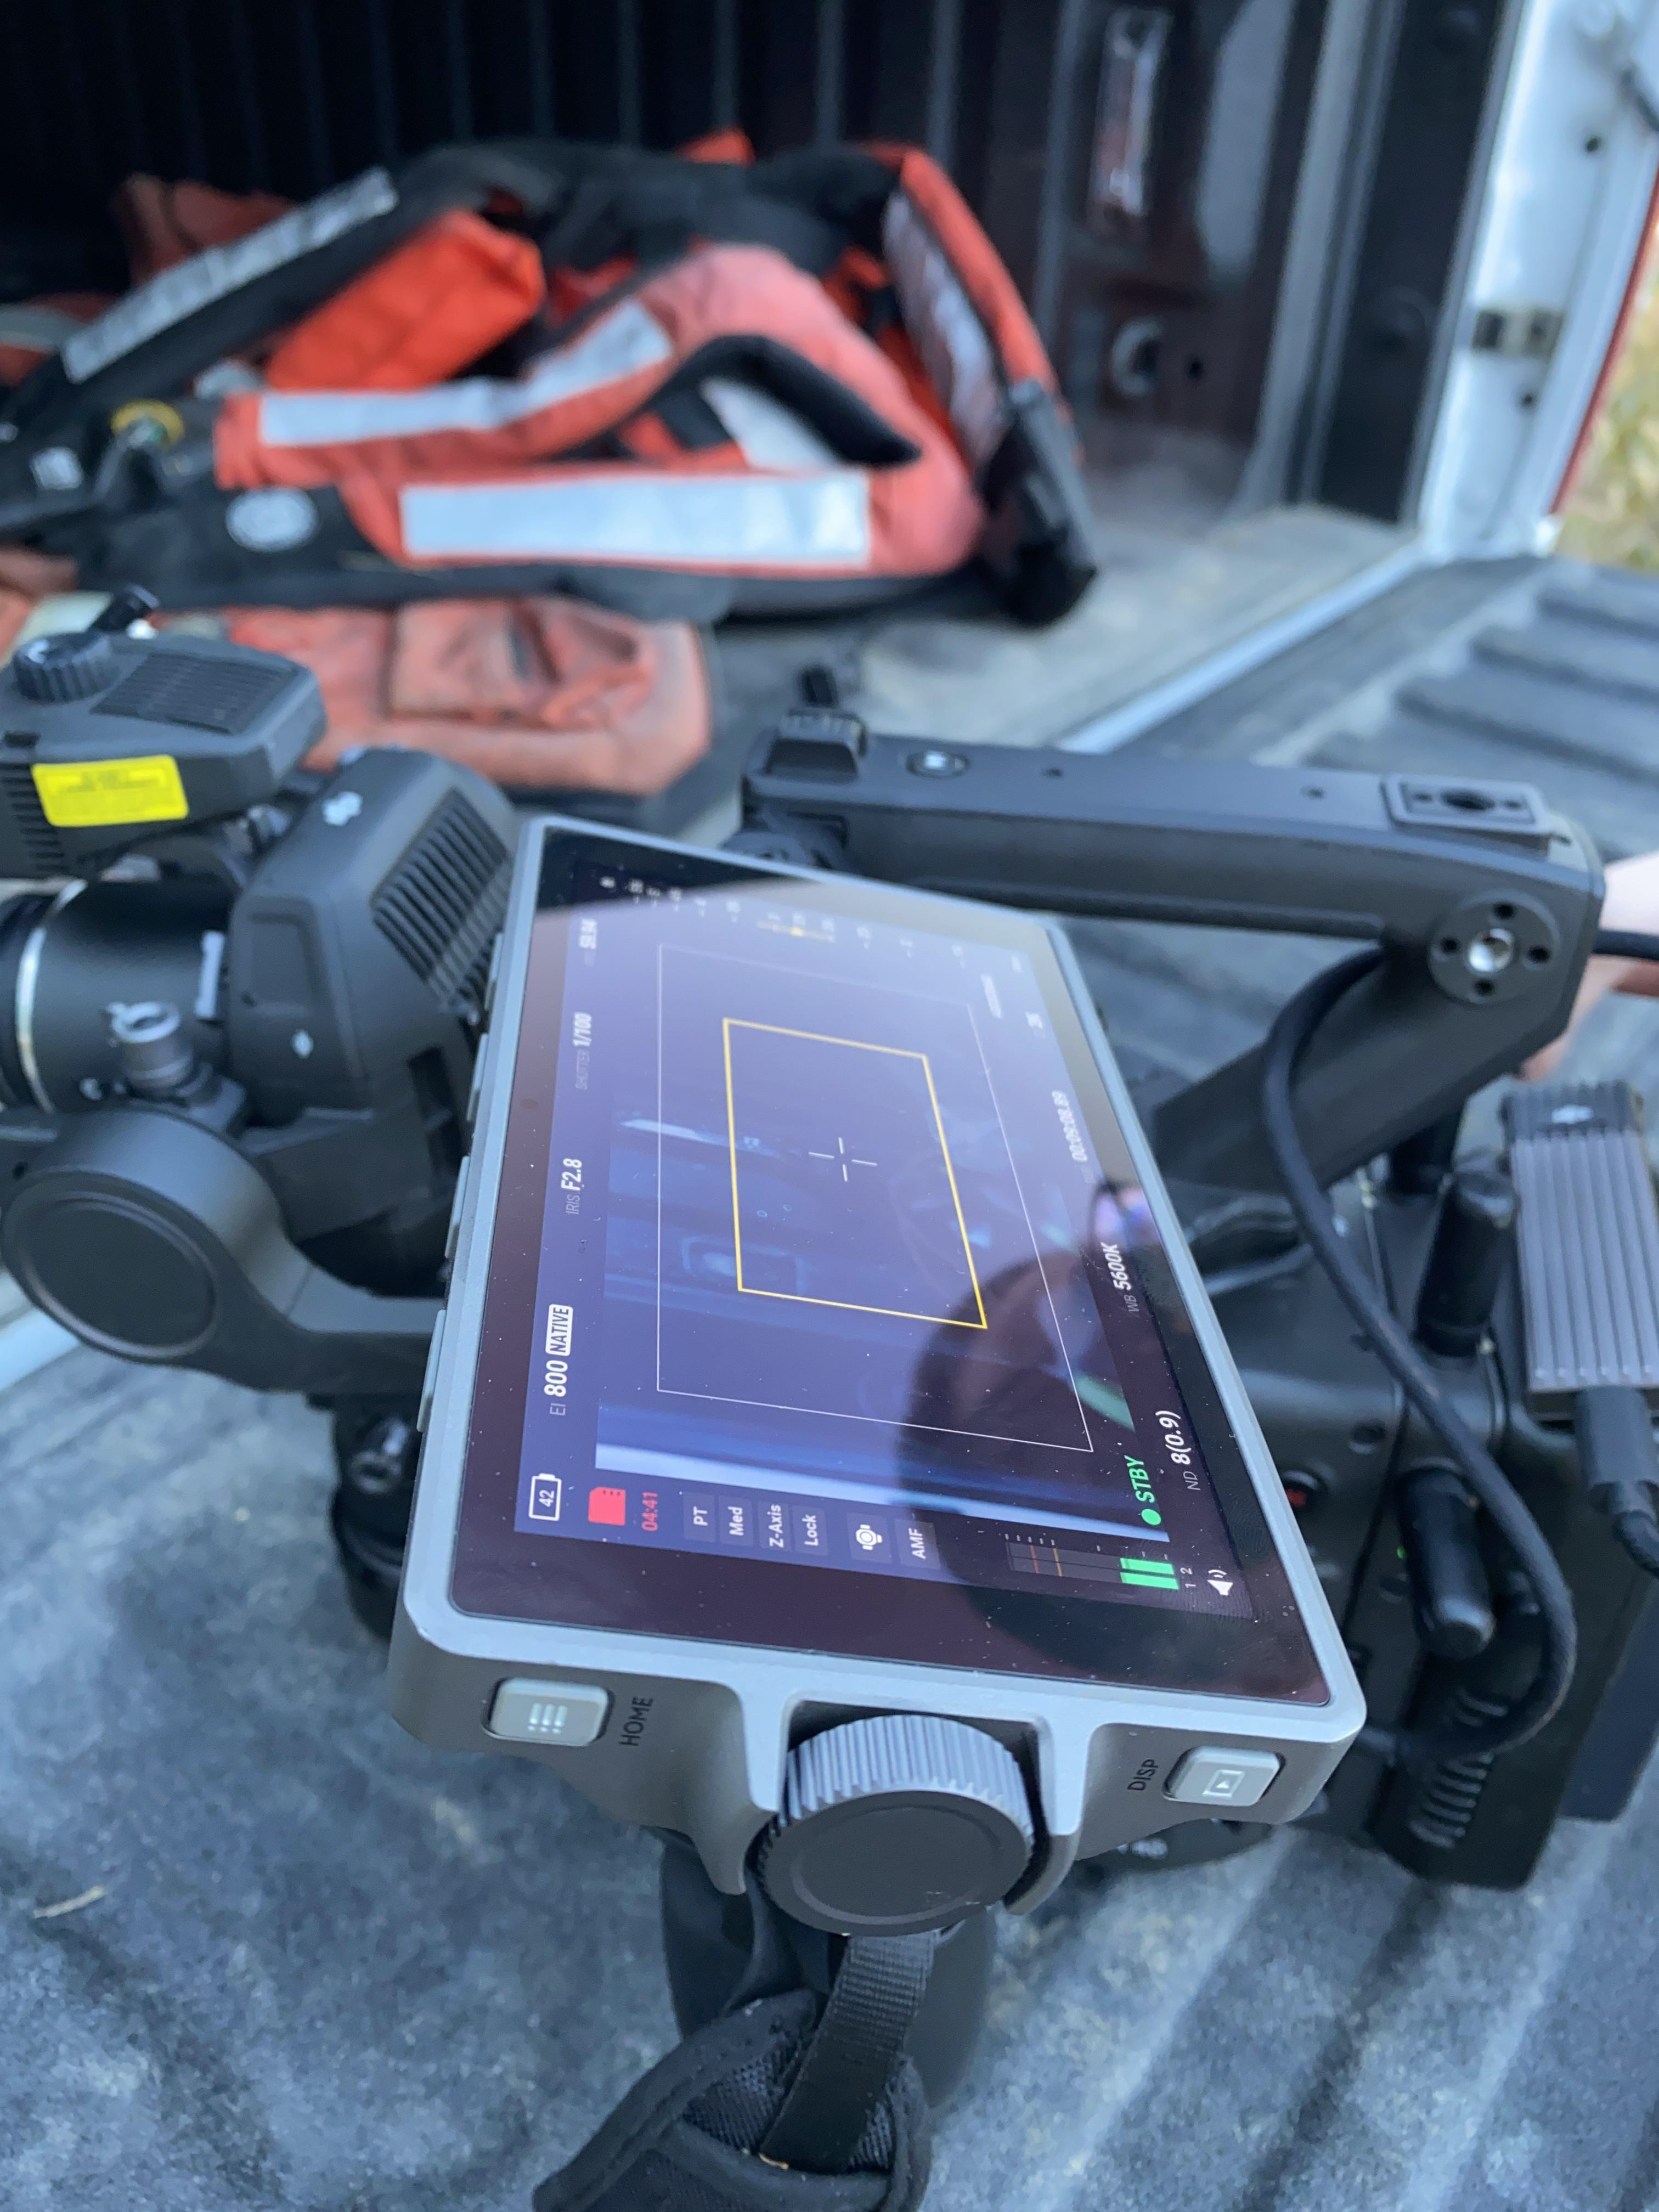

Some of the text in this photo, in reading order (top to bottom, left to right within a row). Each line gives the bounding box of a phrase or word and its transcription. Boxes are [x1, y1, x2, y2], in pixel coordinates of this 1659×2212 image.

[573, 1013, 592, 1047] 1/100
[561, 1158, 583, 1215] IRIS F2.8
[1101, 1242, 1140, 1312] WB 5600K
[544, 1306, 571, 1416] EI 800 NATIVE
[1155, 1410, 1201, 1491] ND 8(0.9)
[1124, 1454, 1155, 1503] STBY
[538, 1489, 555, 1508] 42
[641, 1492, 658, 1531] 04:41
[693, 1506, 708, 1526] PT
[728, 1506, 744, 1536] Med
[767, 1504, 785, 1548] Z-Axis
[802, 1514, 819, 1547] Lock
[908, 1528, 927, 1560] AMF
[1180, 1567, 1193, 1576] 2
[618, 1696, 653, 1747] HOME
[1127, 1758, 1160, 1791] DISP
